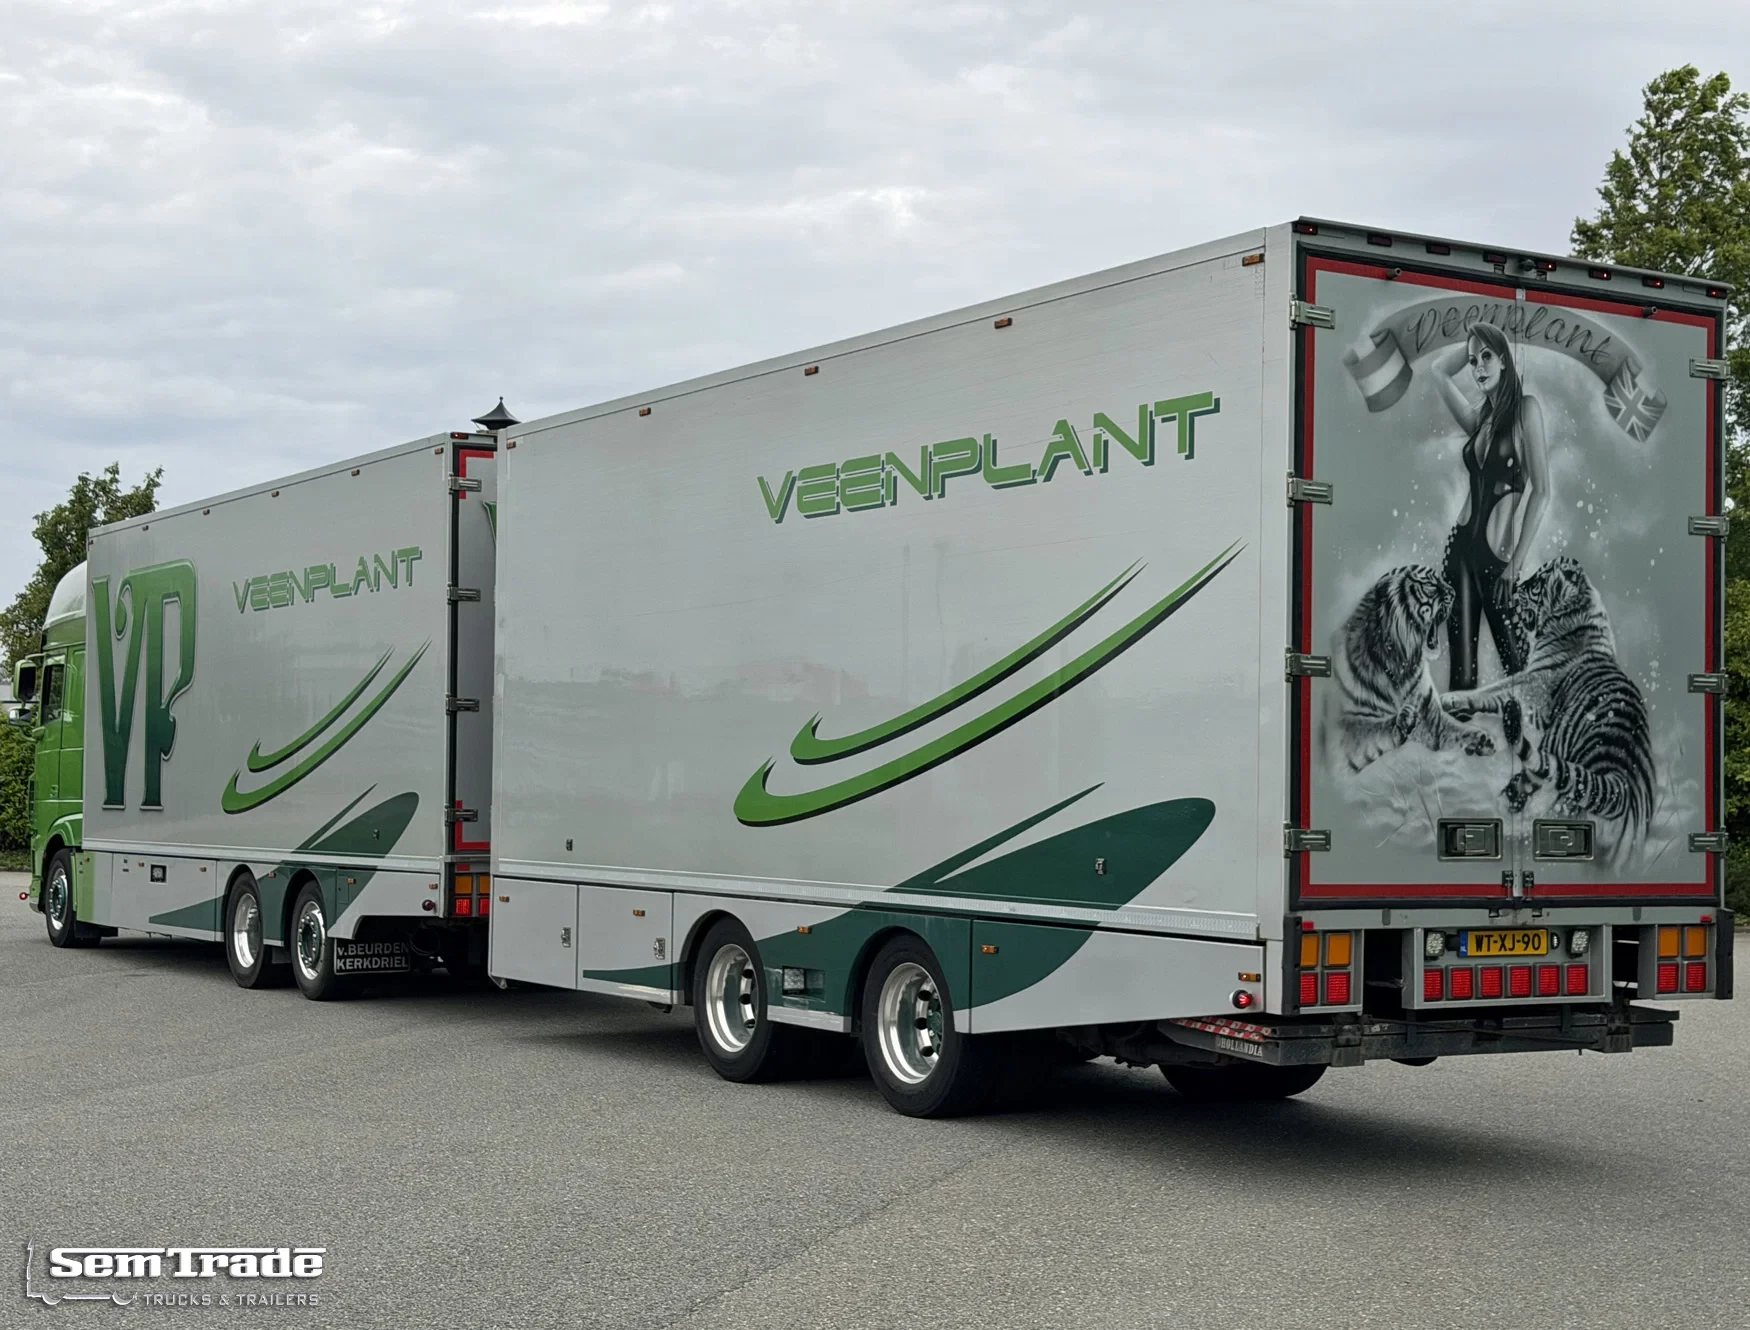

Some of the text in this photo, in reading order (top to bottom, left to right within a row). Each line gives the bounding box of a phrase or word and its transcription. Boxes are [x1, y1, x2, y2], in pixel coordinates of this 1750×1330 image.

[757, 391, 1220, 524] VEENPLANT
[233, 546, 422, 614] VEENPLANT
[337, 957, 408, 970] KERKDRIEL
[1475, 933, 1542, 953] WT-XJ-90
